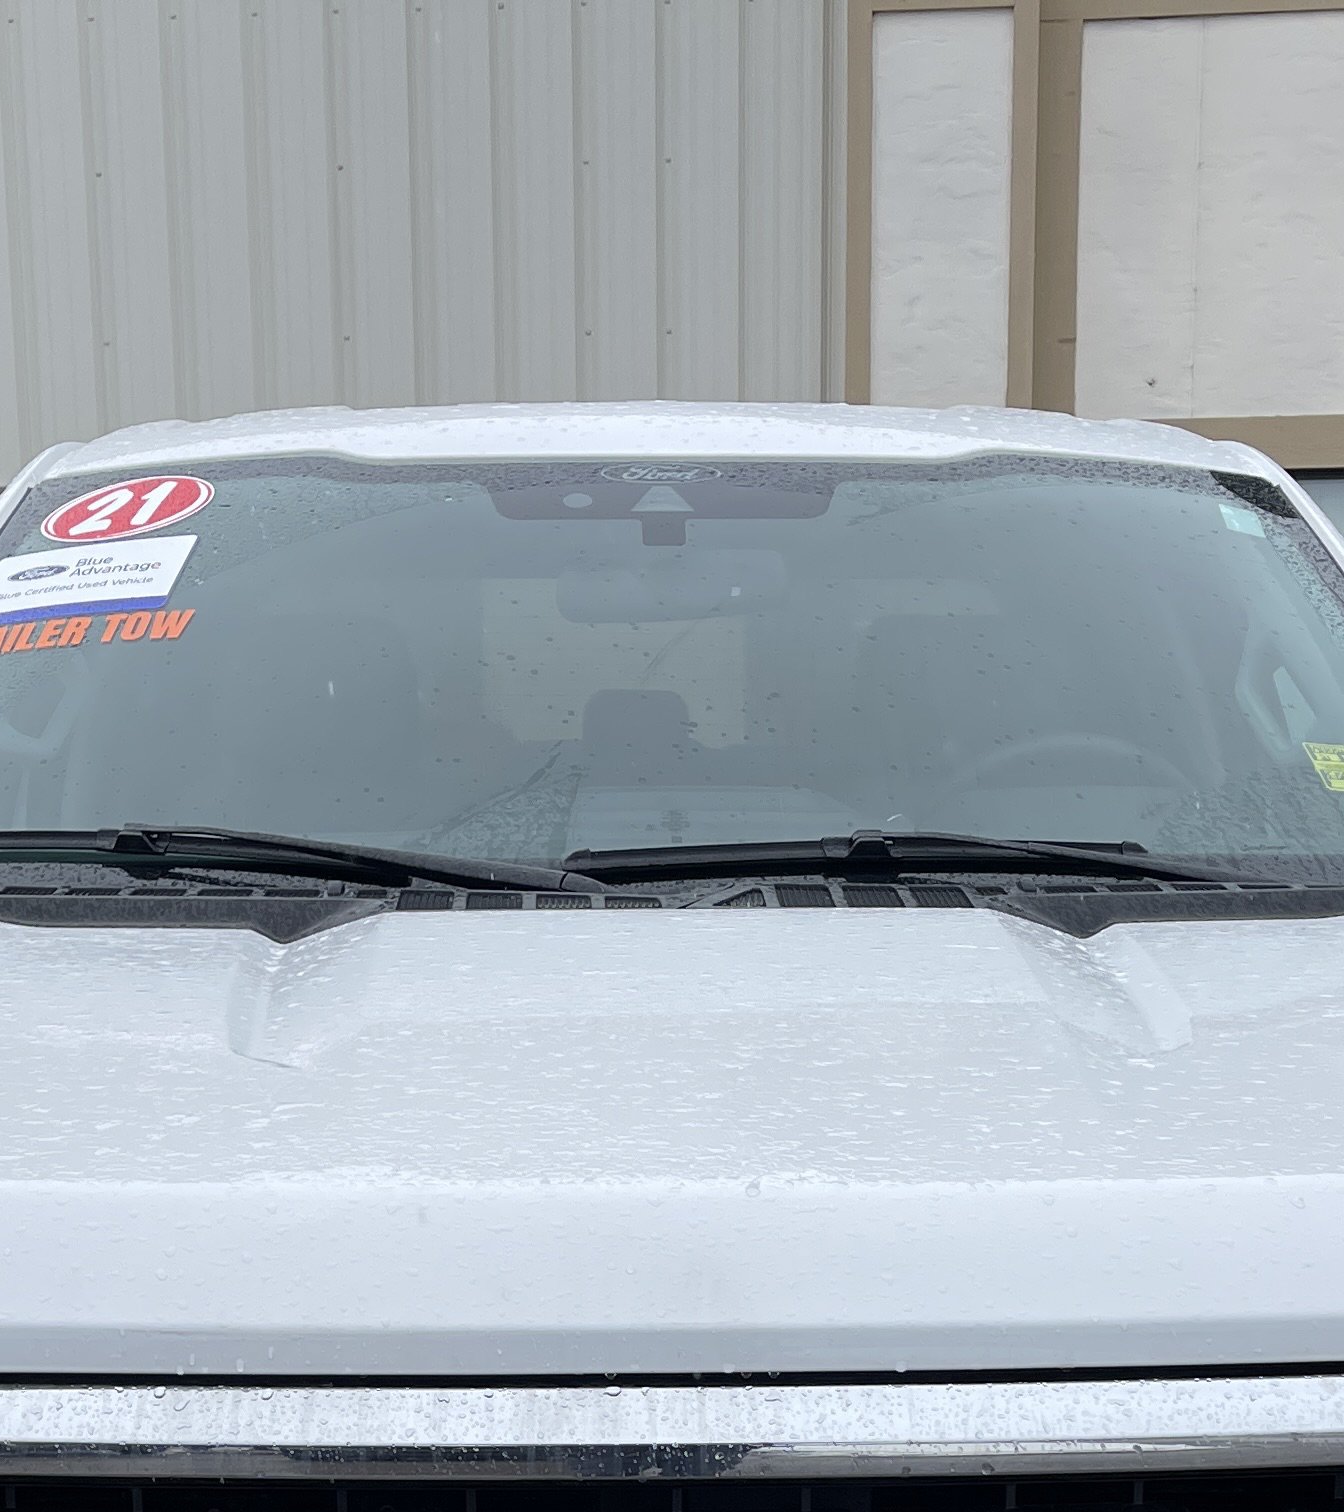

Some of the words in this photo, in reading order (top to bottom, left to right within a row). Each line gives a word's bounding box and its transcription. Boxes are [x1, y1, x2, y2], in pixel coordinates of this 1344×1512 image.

[622, 464, 700, 480] Ford
[67, 480, 178, 537] 21
[69, 561, 162, 578] Advantage
[75, 556, 114, 567] Blue
[24, 583, 74, 597] Certified
[77, 579, 108, 590] Used
[112, 576, 154, 586] Vehicle
[100, 608, 196, 644] TOW
